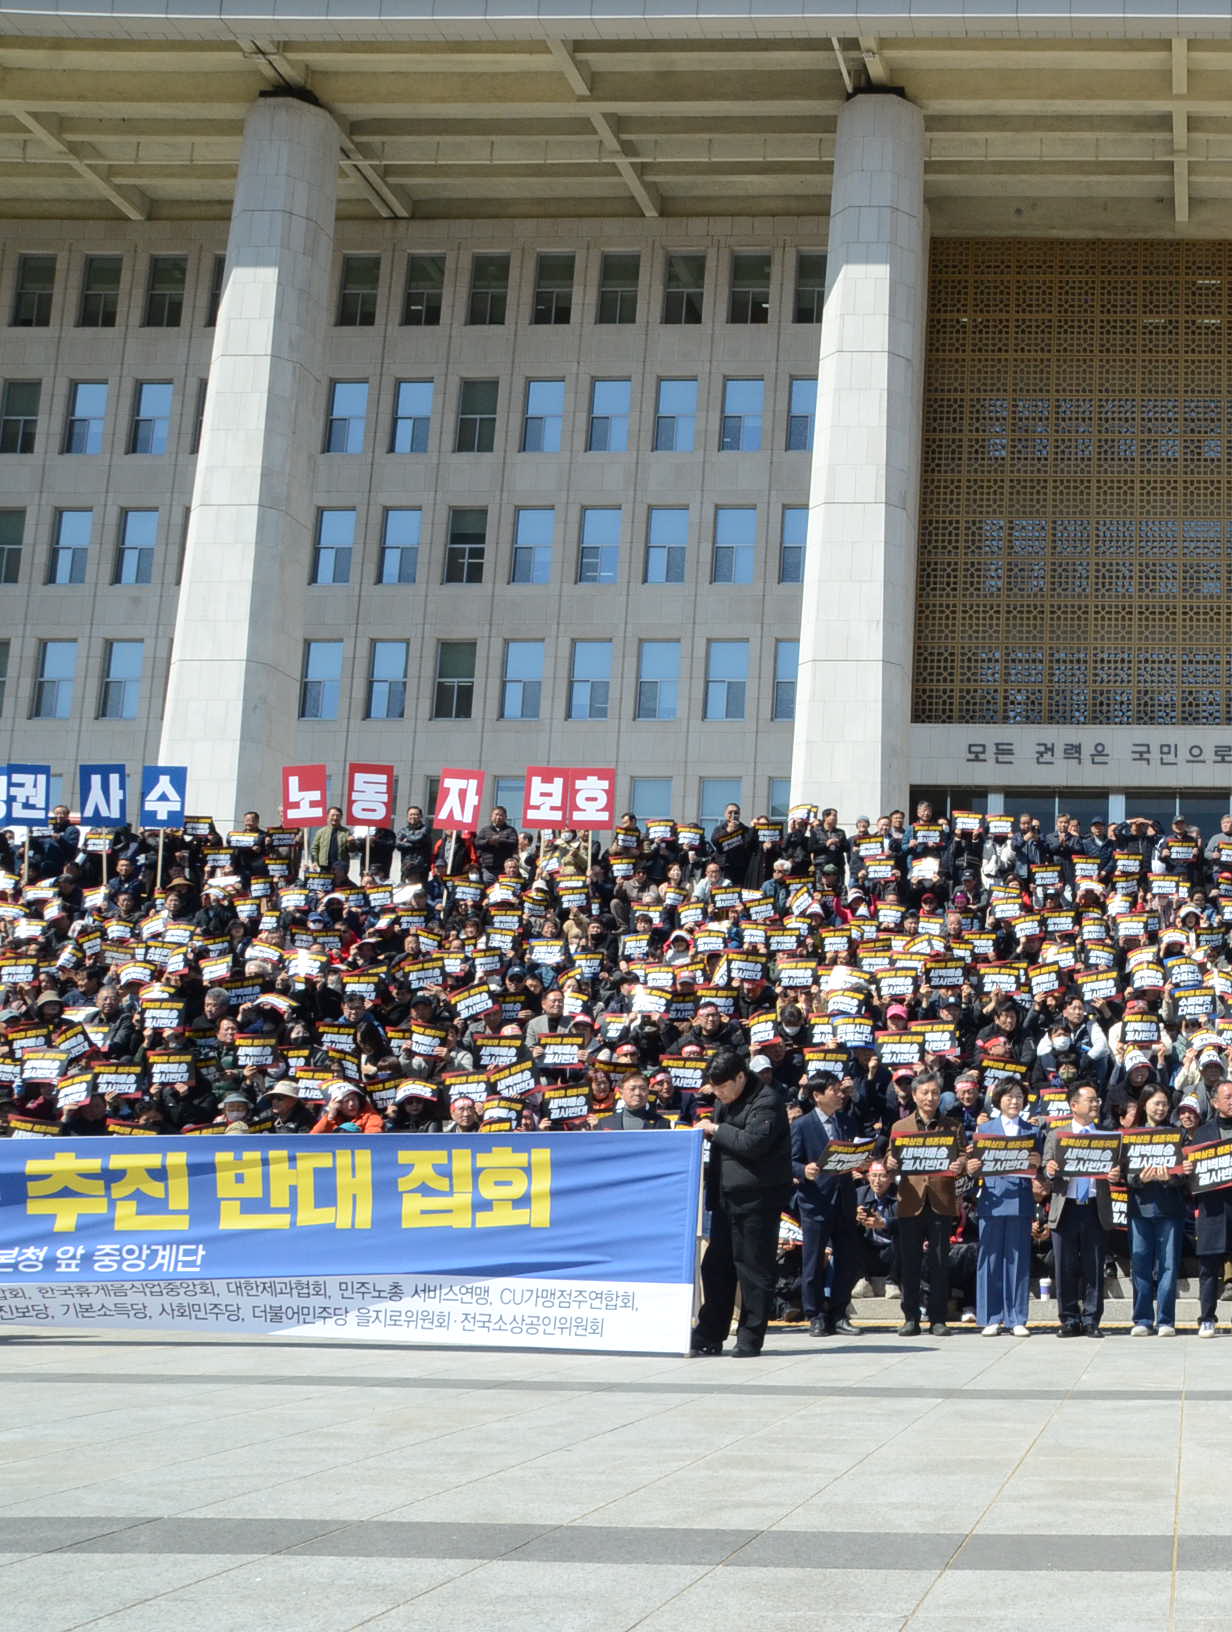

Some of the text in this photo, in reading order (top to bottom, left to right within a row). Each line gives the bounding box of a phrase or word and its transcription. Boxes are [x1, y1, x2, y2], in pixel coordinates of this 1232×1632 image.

[966, 742, 1015, 765] 모든
[1035, 742, 1110, 766] 권력은
[9, 773, 47, 819] 권
[83, 774, 124, 819] 사
[145, 775, 181, 820] 수
[900, 1147, 949, 1159] 새벽배송
[982, 1149, 1029, 1161] 새벽배송
[1064, 1149, 1112, 1161] 새벽배송
[1127, 1144, 1175, 1157] 새벽배송
[902, 1158, 949, 1171] 결사반대
[982, 1160, 1029, 1171] 결사반대
[1064, 1160, 1112, 1172] 결사반대
[1129, 1156, 1175, 1168] 결사반대
[25, 1147, 551, 1232] 추진 반대 집회
[55, 1245, 86, 1272] 앞
[92, 1244, 206, 1273] 중앙계단
[227, 1280, 331, 1300] 대한제과협회,
[338, 1281, 404, 1302] 민주노총
[411, 1284, 493, 1306] 서비스연맹,
[500, 1286, 639, 1311] CU가맹점주연합회,
[61, 1302, 152, 1320] 기본소득당,
[159, 1302, 245, 1322] 사회민주당,
[252, 1303, 348, 1326] 더불어민주당
